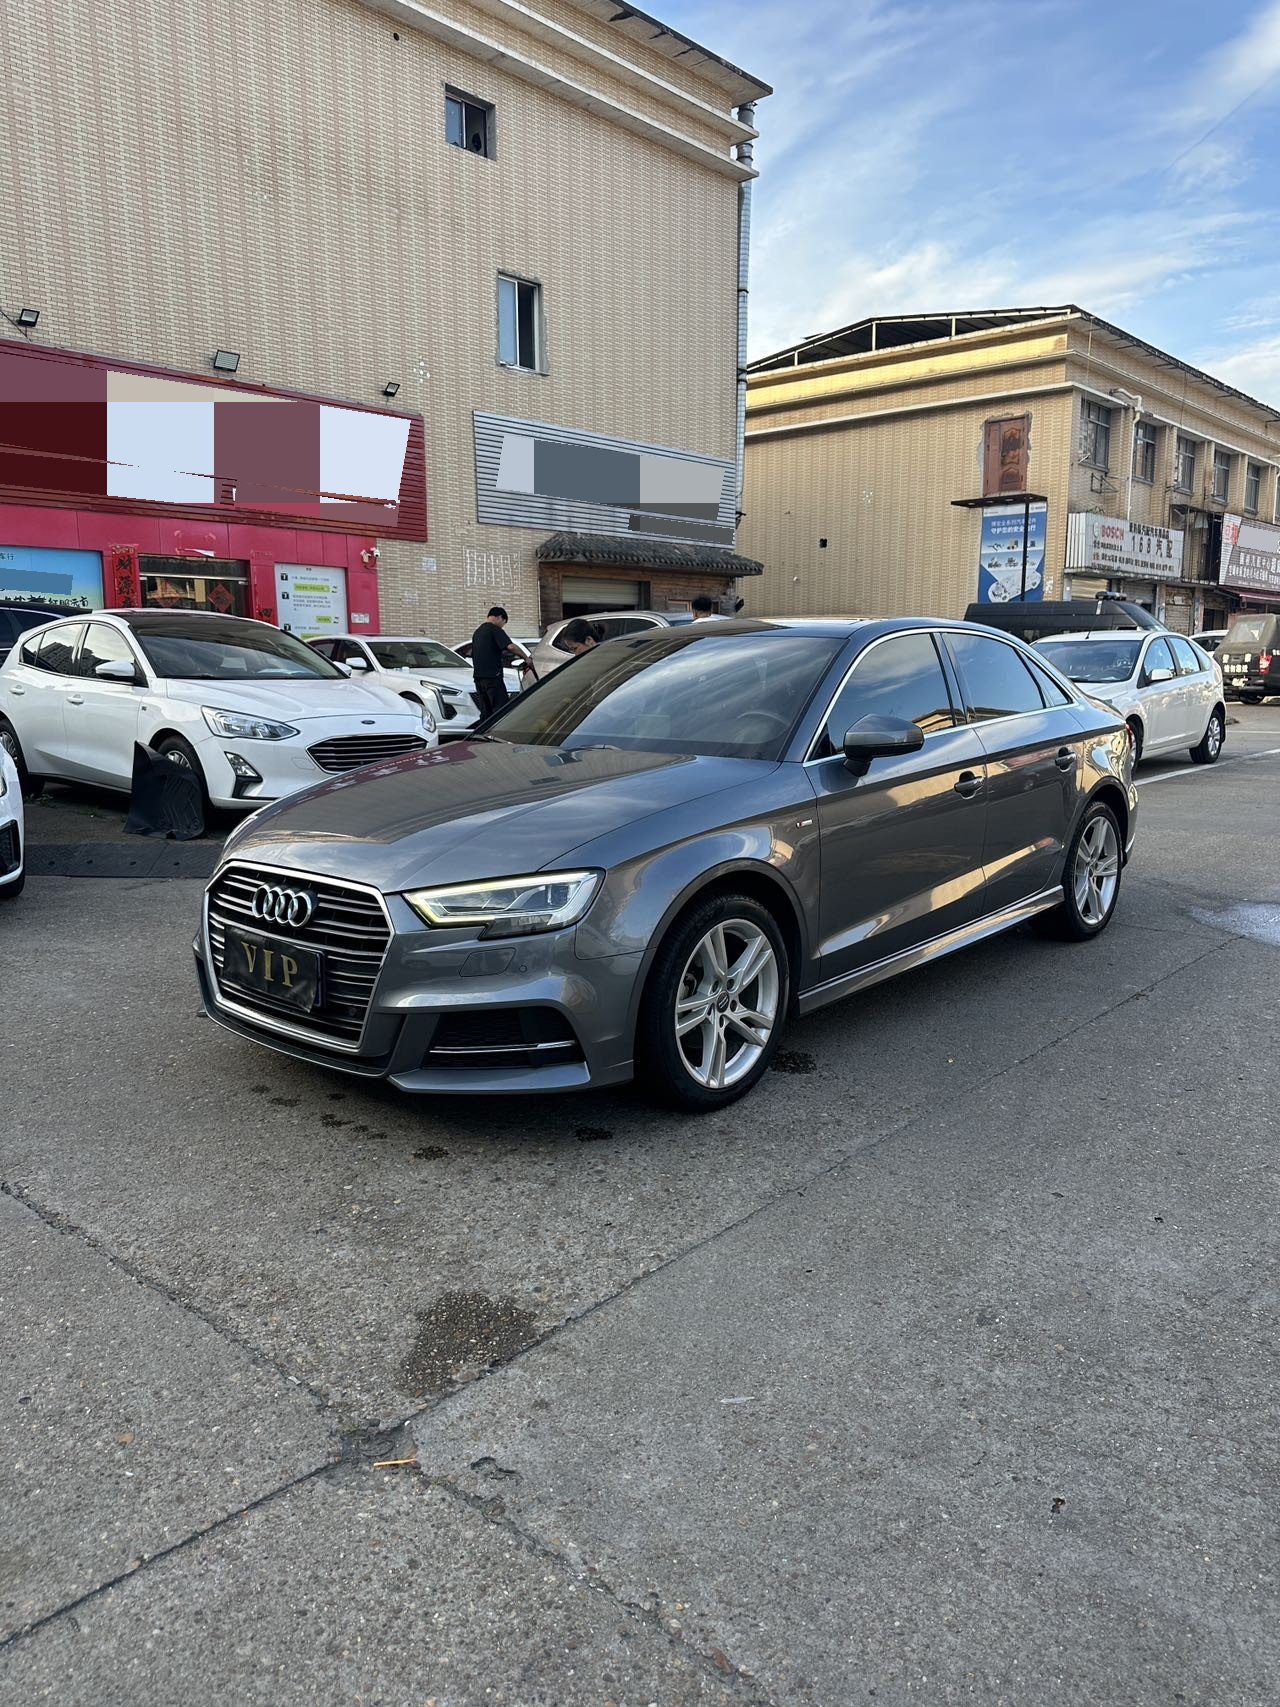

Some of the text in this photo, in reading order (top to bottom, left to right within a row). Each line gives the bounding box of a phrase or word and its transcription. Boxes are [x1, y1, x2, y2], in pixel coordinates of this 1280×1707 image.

[990, 525, 1036, 535] 守护您的安全行
[1101, 525, 1125, 540] BOSCH
[240, 941, 298, 987] VIP
